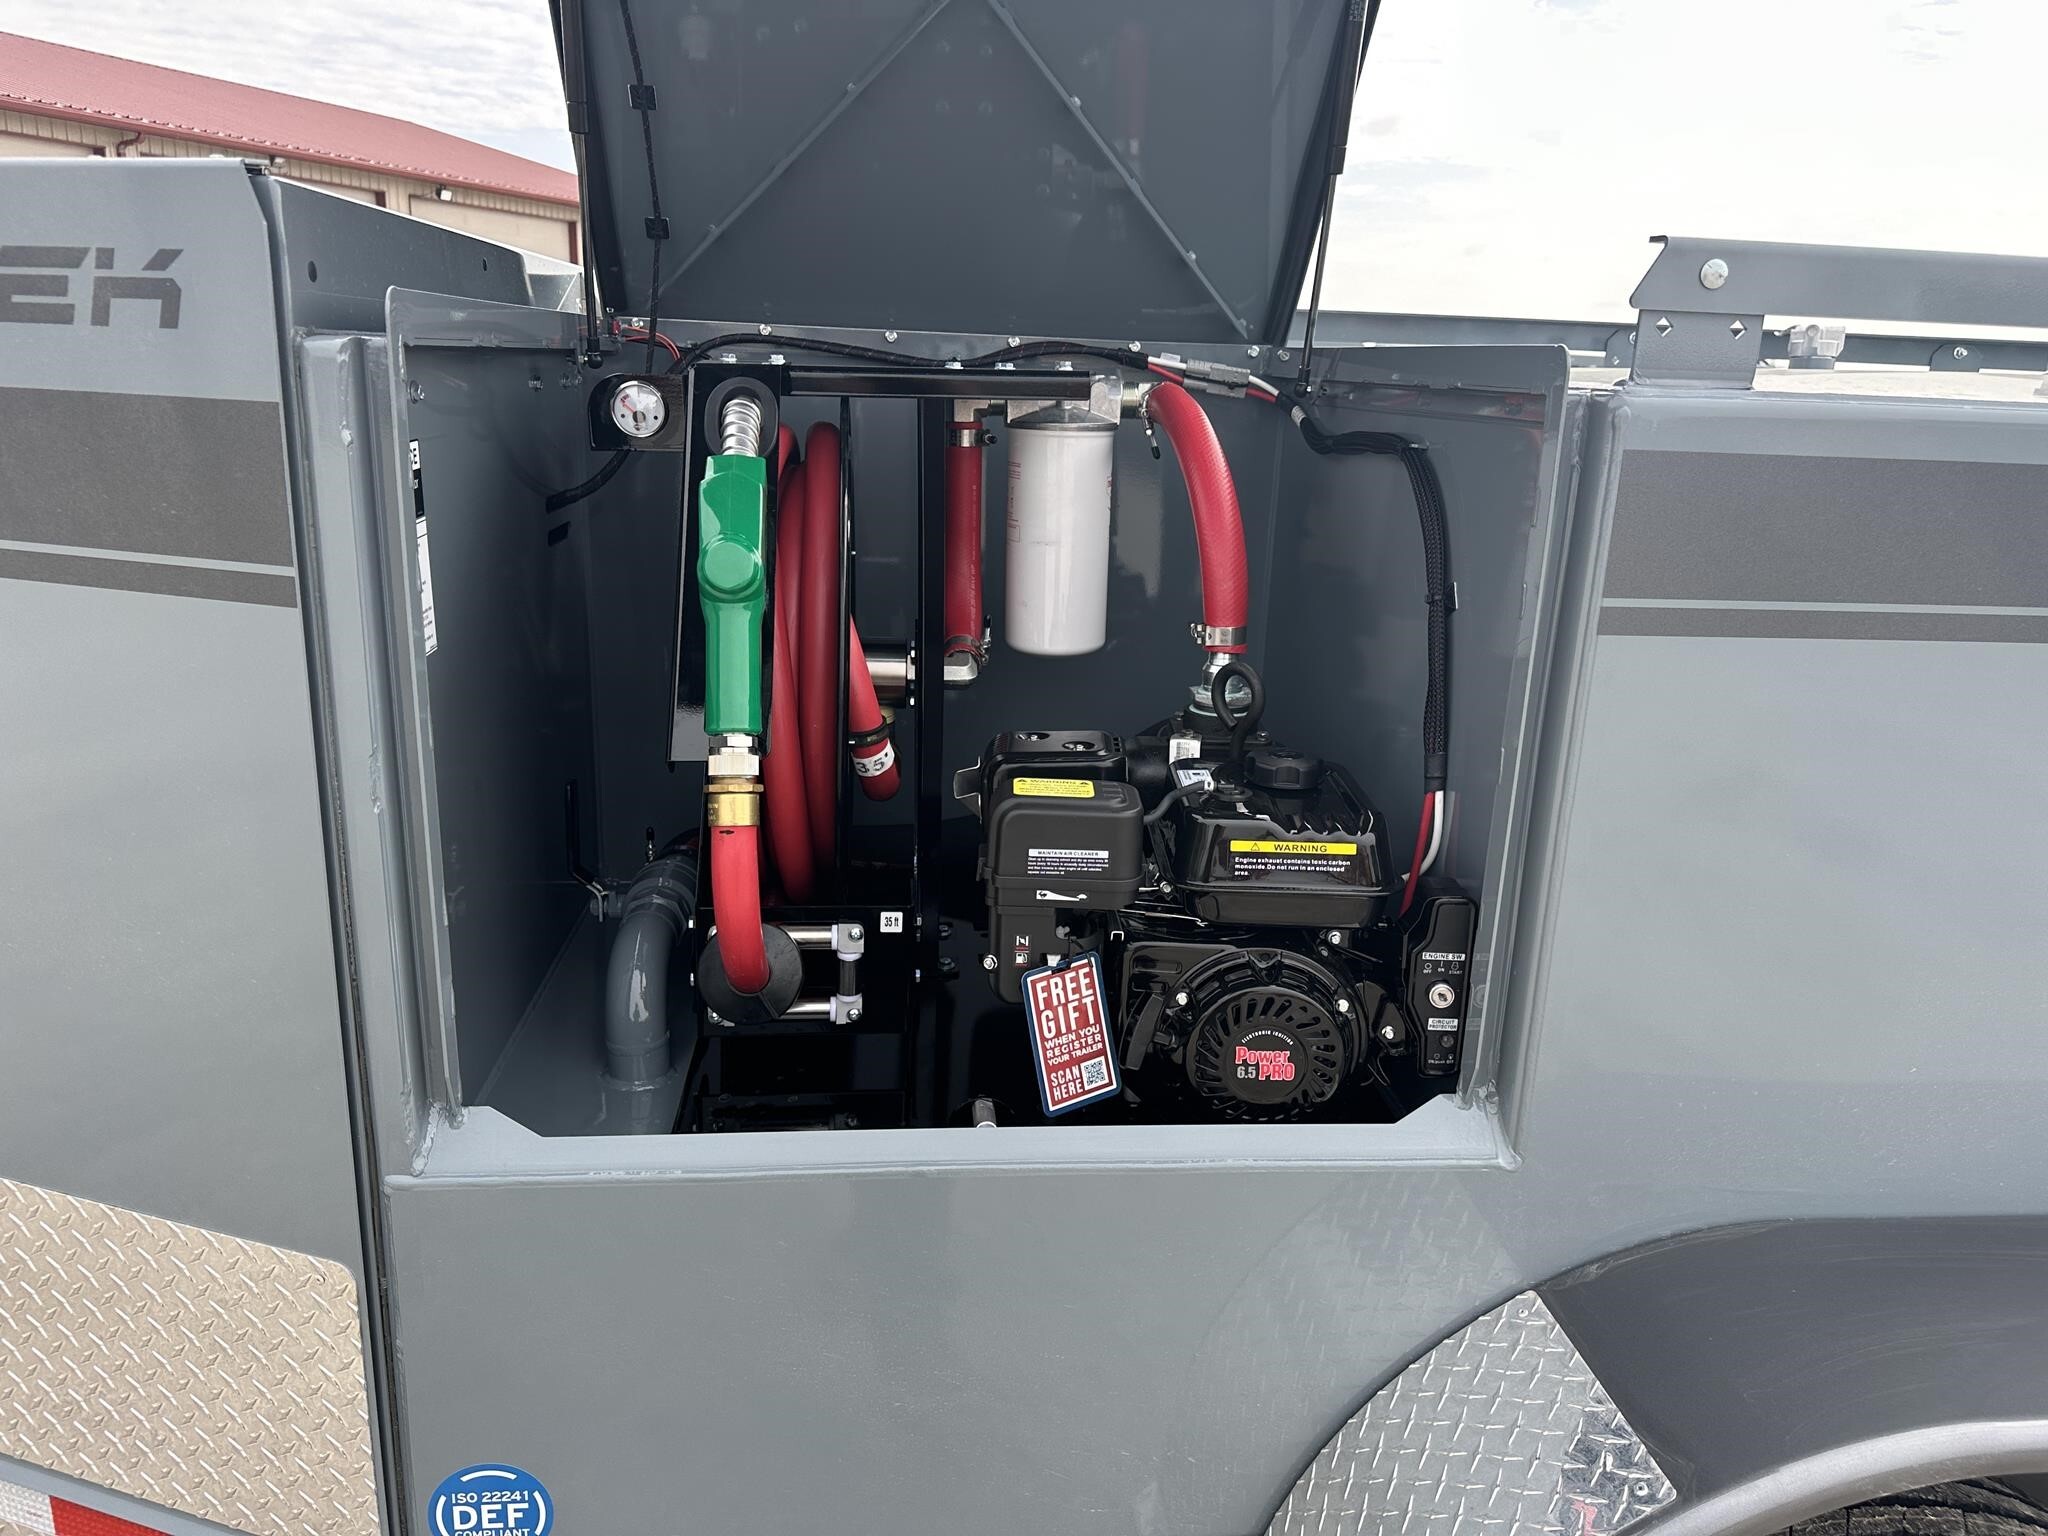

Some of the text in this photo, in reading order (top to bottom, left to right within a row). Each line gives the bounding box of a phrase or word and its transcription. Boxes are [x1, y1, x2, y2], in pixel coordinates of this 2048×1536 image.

[1273, 844, 1328, 853] WARNING
[884, 916, 899, 927] 35 ft
[1036, 967, 1094, 1011] FREE
[1040, 995, 1095, 1039] GIFT
[1044, 1024, 1100, 1049] WHEN YOU
[1046, 1033, 1102, 1059] REGISTER
[1047, 1042, 1103, 1066] YOUR TRAILER
[1235, 1046, 1290, 1064] Power
[1050, 1064, 1080, 1087] SCAN
[1236, 1063, 1295, 1081] 6.5 PRO
[1053, 1079, 1083, 1101] HERE
[451, 1490, 529, 1504] ISO 22241
[452, 1502, 529, 1530] DEF
